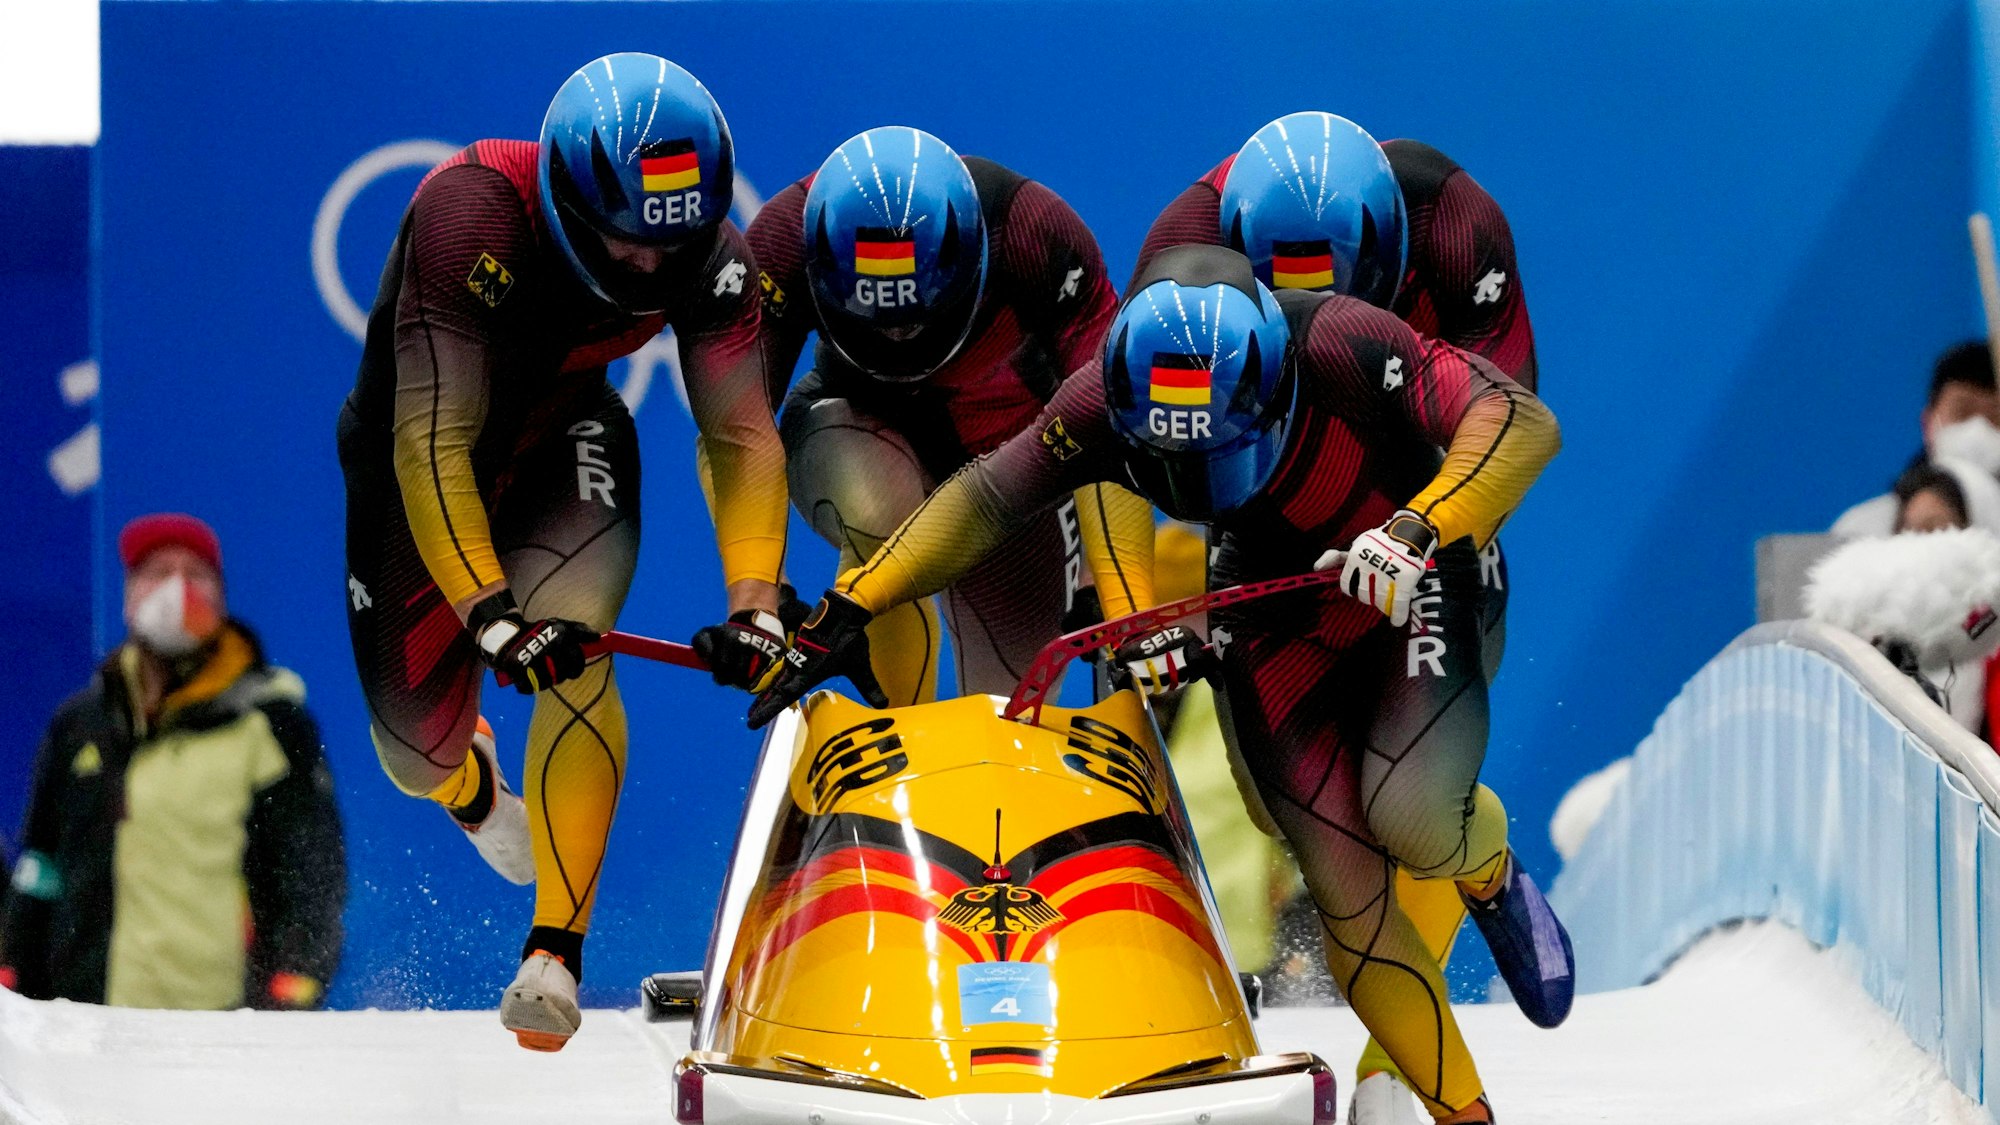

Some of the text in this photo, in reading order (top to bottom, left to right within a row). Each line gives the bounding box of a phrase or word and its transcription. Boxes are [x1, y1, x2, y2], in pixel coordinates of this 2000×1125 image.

[643, 190, 702, 225] GER
[855, 278, 918, 307] GER
[1148, 407, 1212, 439] GER
[806, 717, 909, 815] GER
[1062, 715, 1158, 816] GER
[990, 997, 1021, 1017] 4
